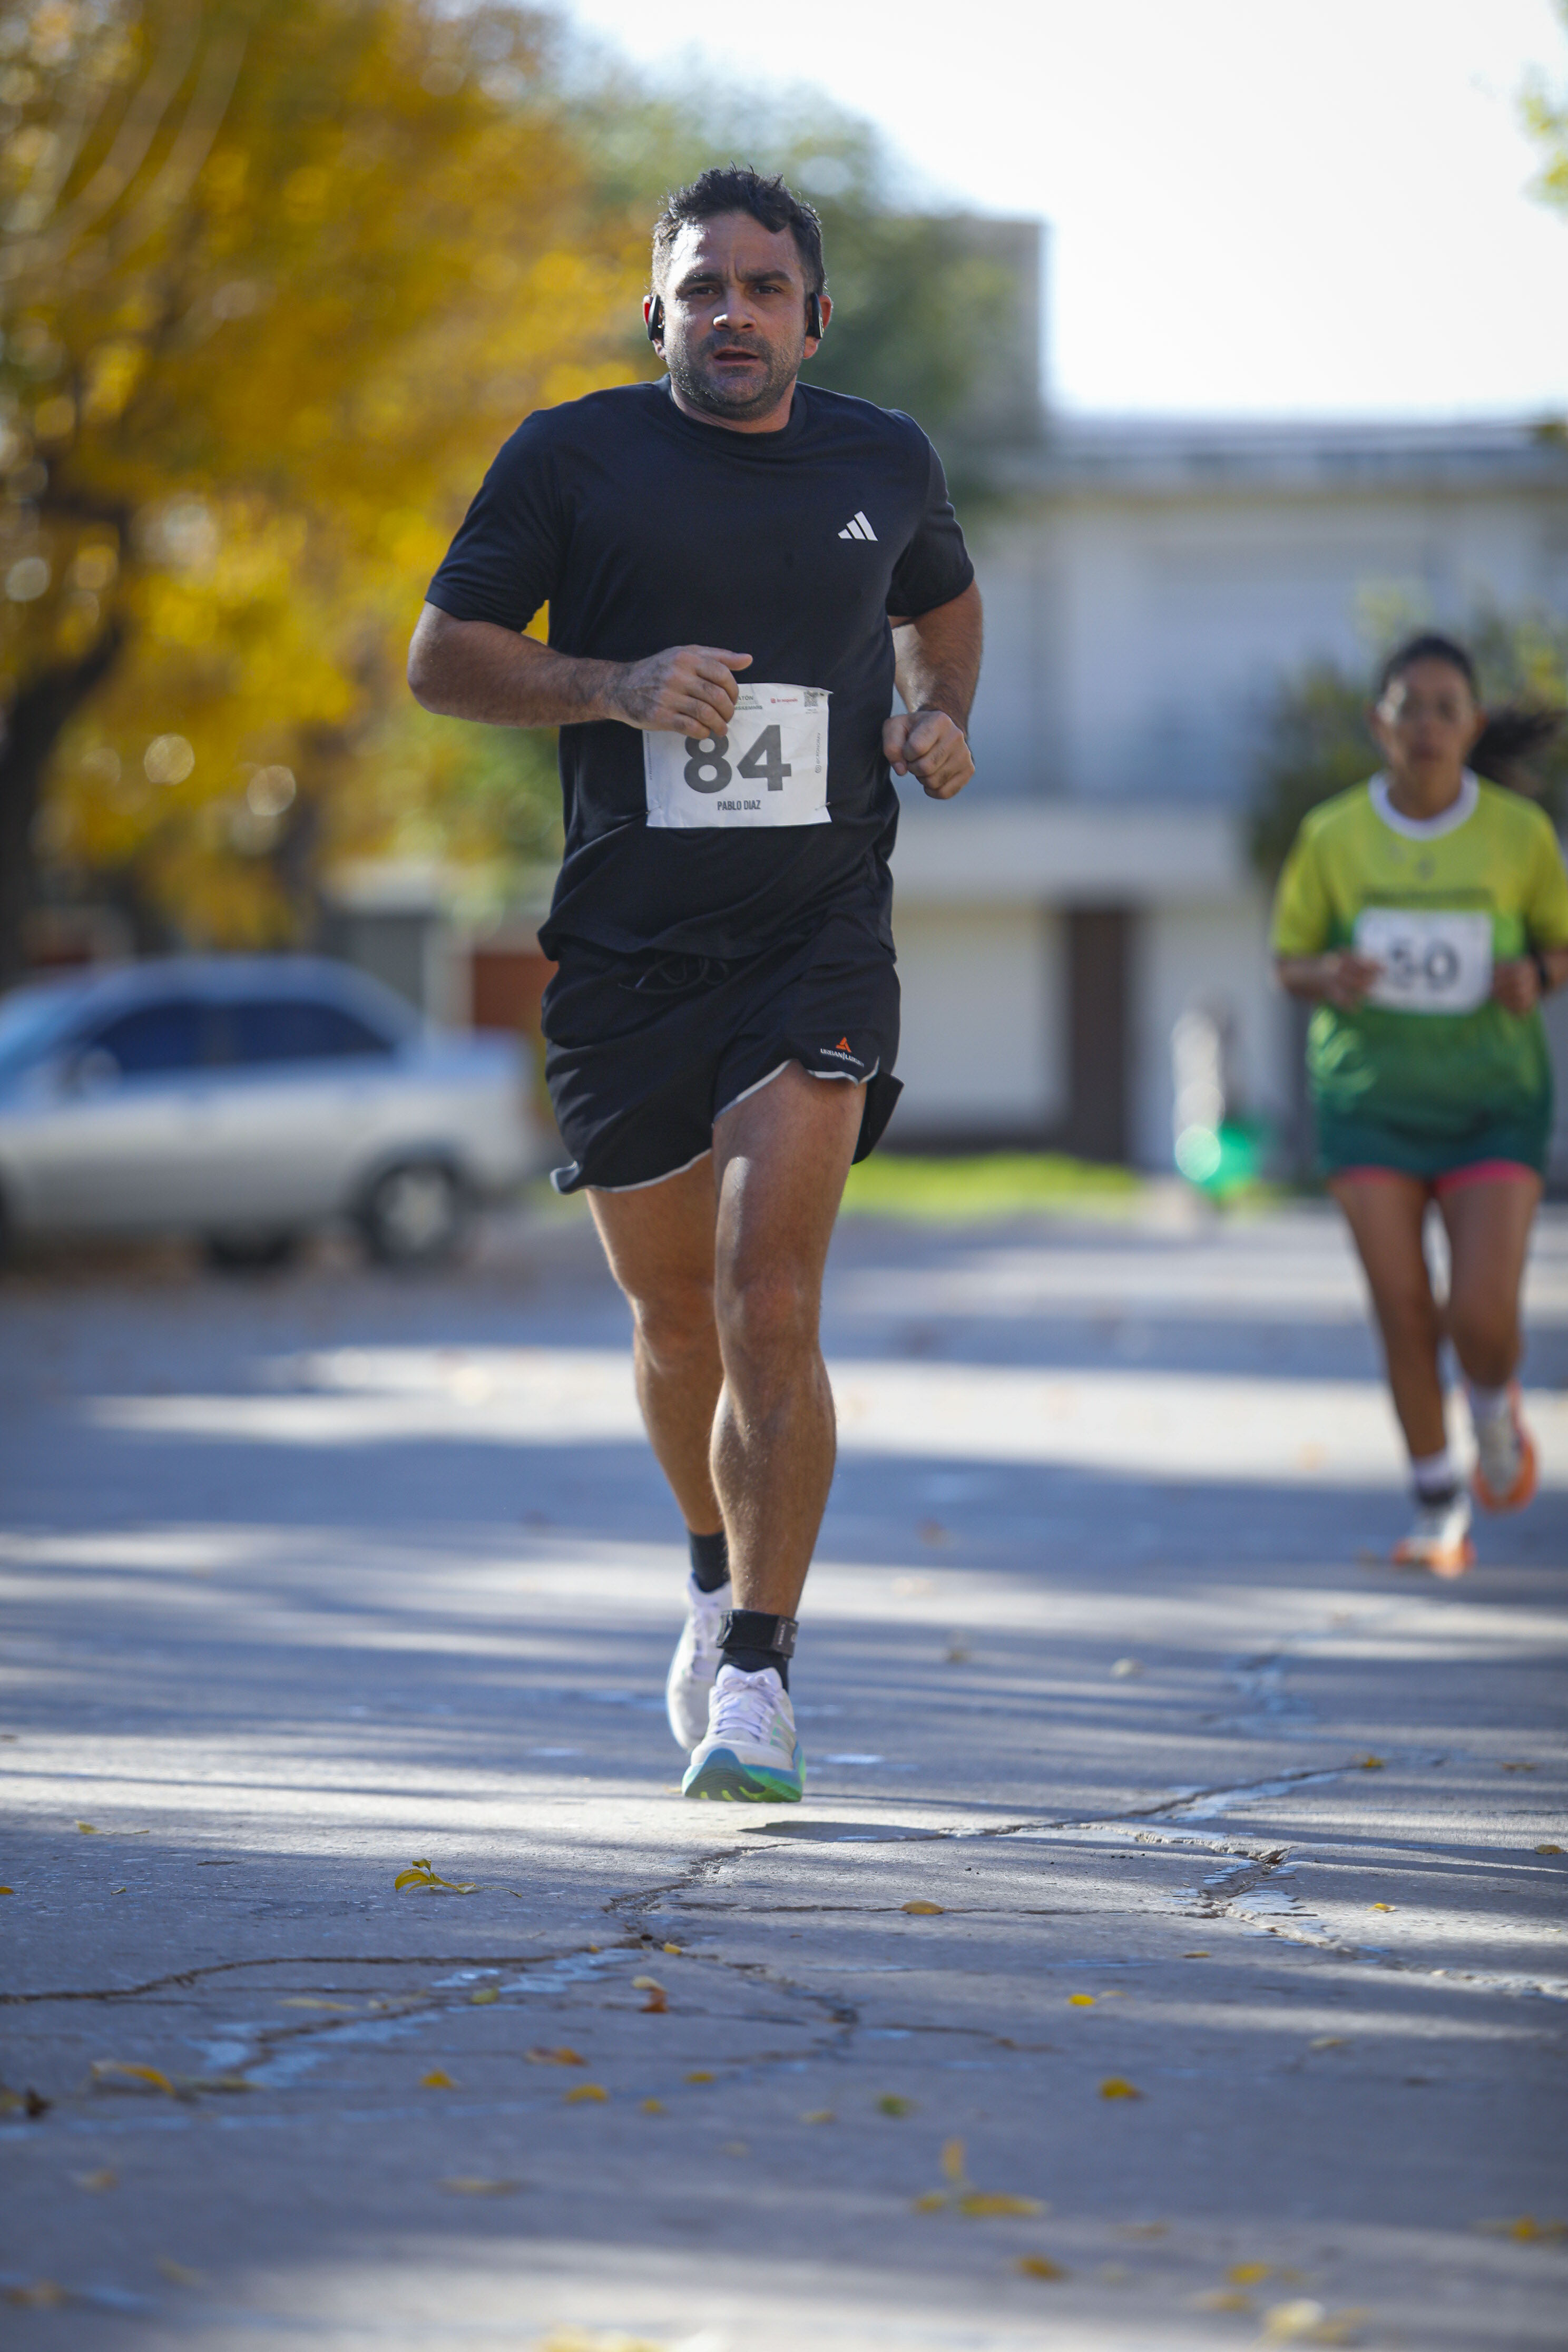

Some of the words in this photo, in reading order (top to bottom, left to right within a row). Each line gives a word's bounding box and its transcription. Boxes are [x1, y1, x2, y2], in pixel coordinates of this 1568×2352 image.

[684, 724, 792, 793] 84
[717, 800, 741, 811] PABLO
[743, 800, 761, 810] DIAZ
